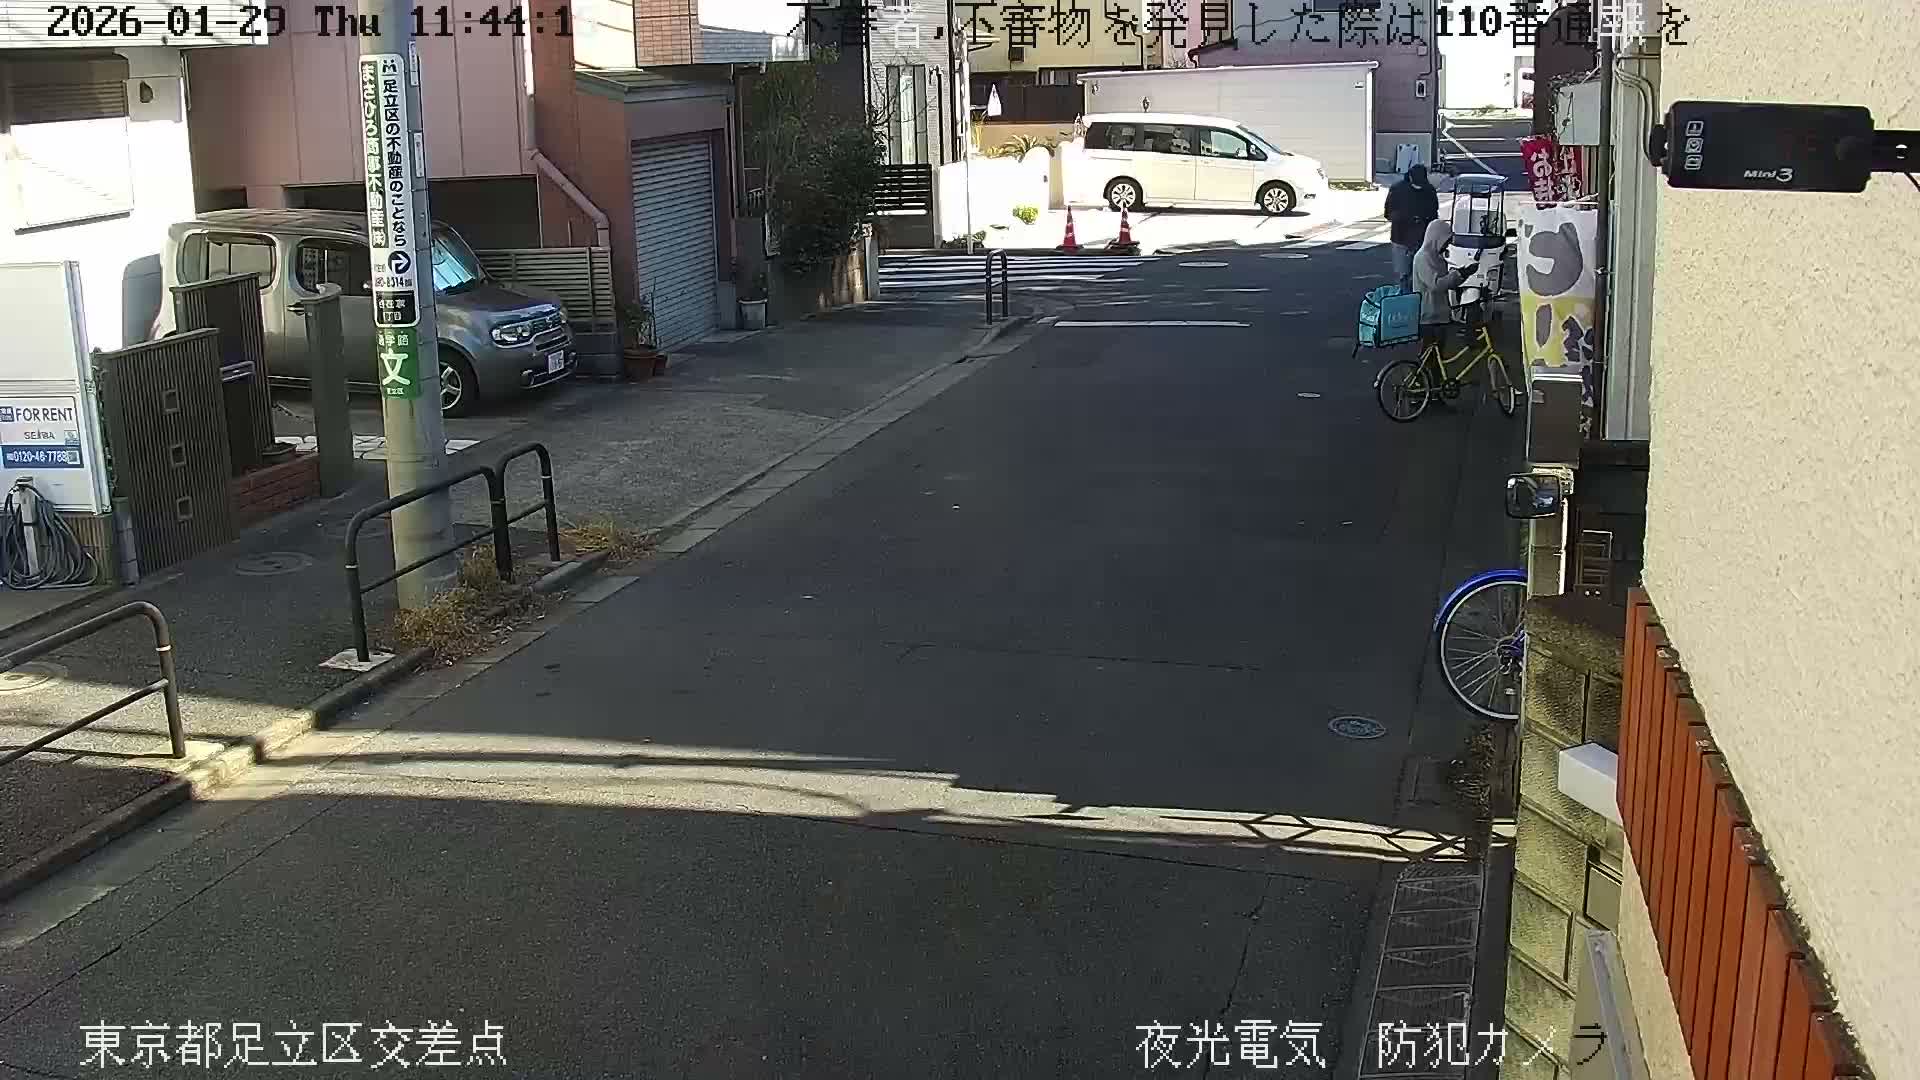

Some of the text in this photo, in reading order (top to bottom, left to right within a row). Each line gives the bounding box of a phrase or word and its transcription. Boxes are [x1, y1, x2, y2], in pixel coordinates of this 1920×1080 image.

[383, 79, 407, 247] 足立区の不動産のことなら
[380, 347, 411, 386] 文
[15, 407, 41, 421] FOR
[42, 407, 73, 421] RENT
